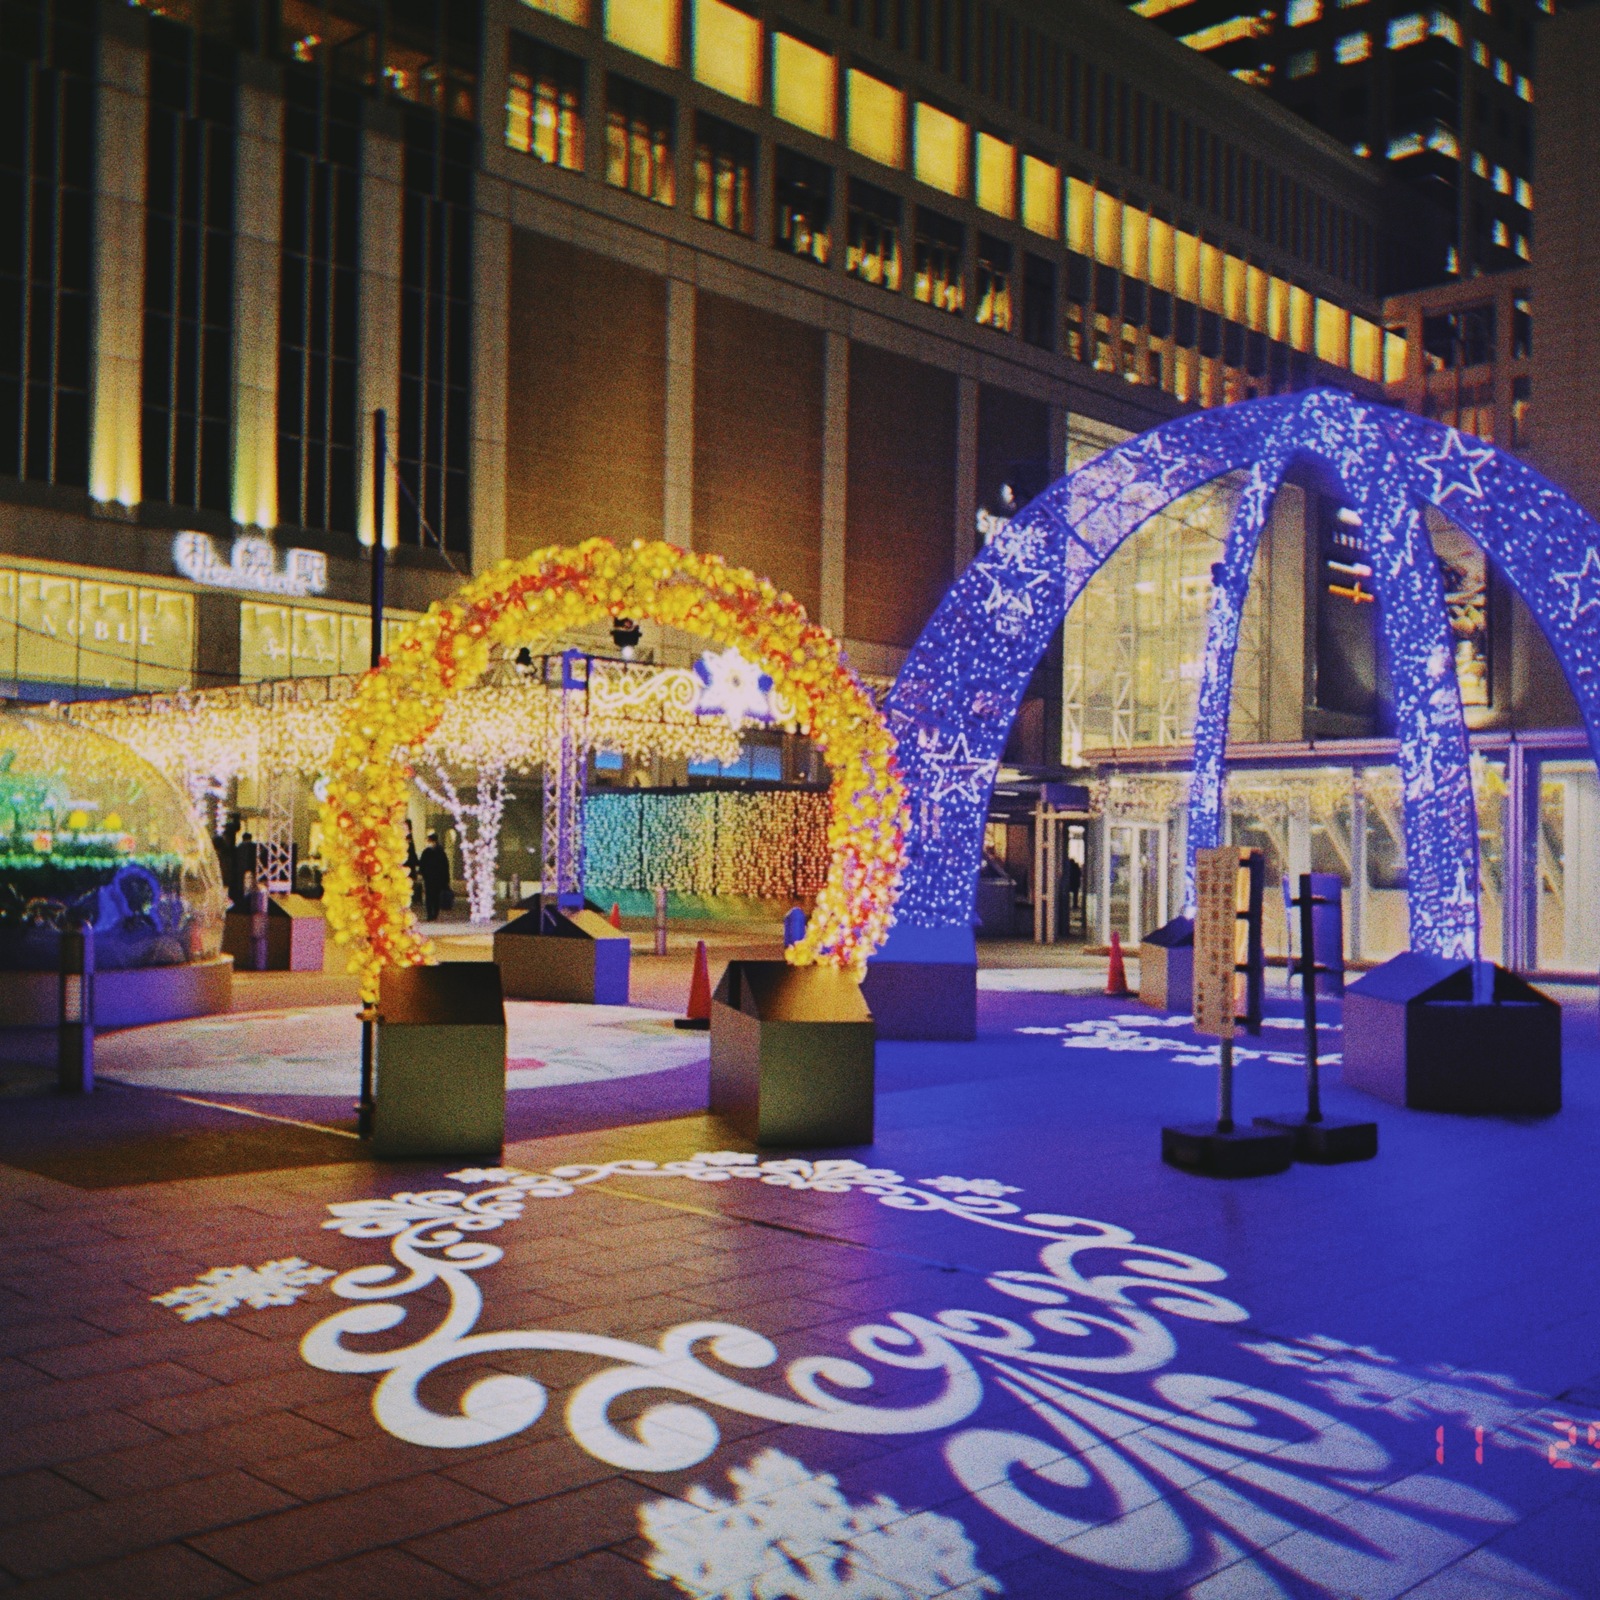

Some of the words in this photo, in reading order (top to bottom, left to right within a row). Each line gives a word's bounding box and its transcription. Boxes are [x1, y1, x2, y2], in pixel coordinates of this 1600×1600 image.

[177, 532, 328, 591] 札幌駅
[40, 613, 156, 647] NOBLE
